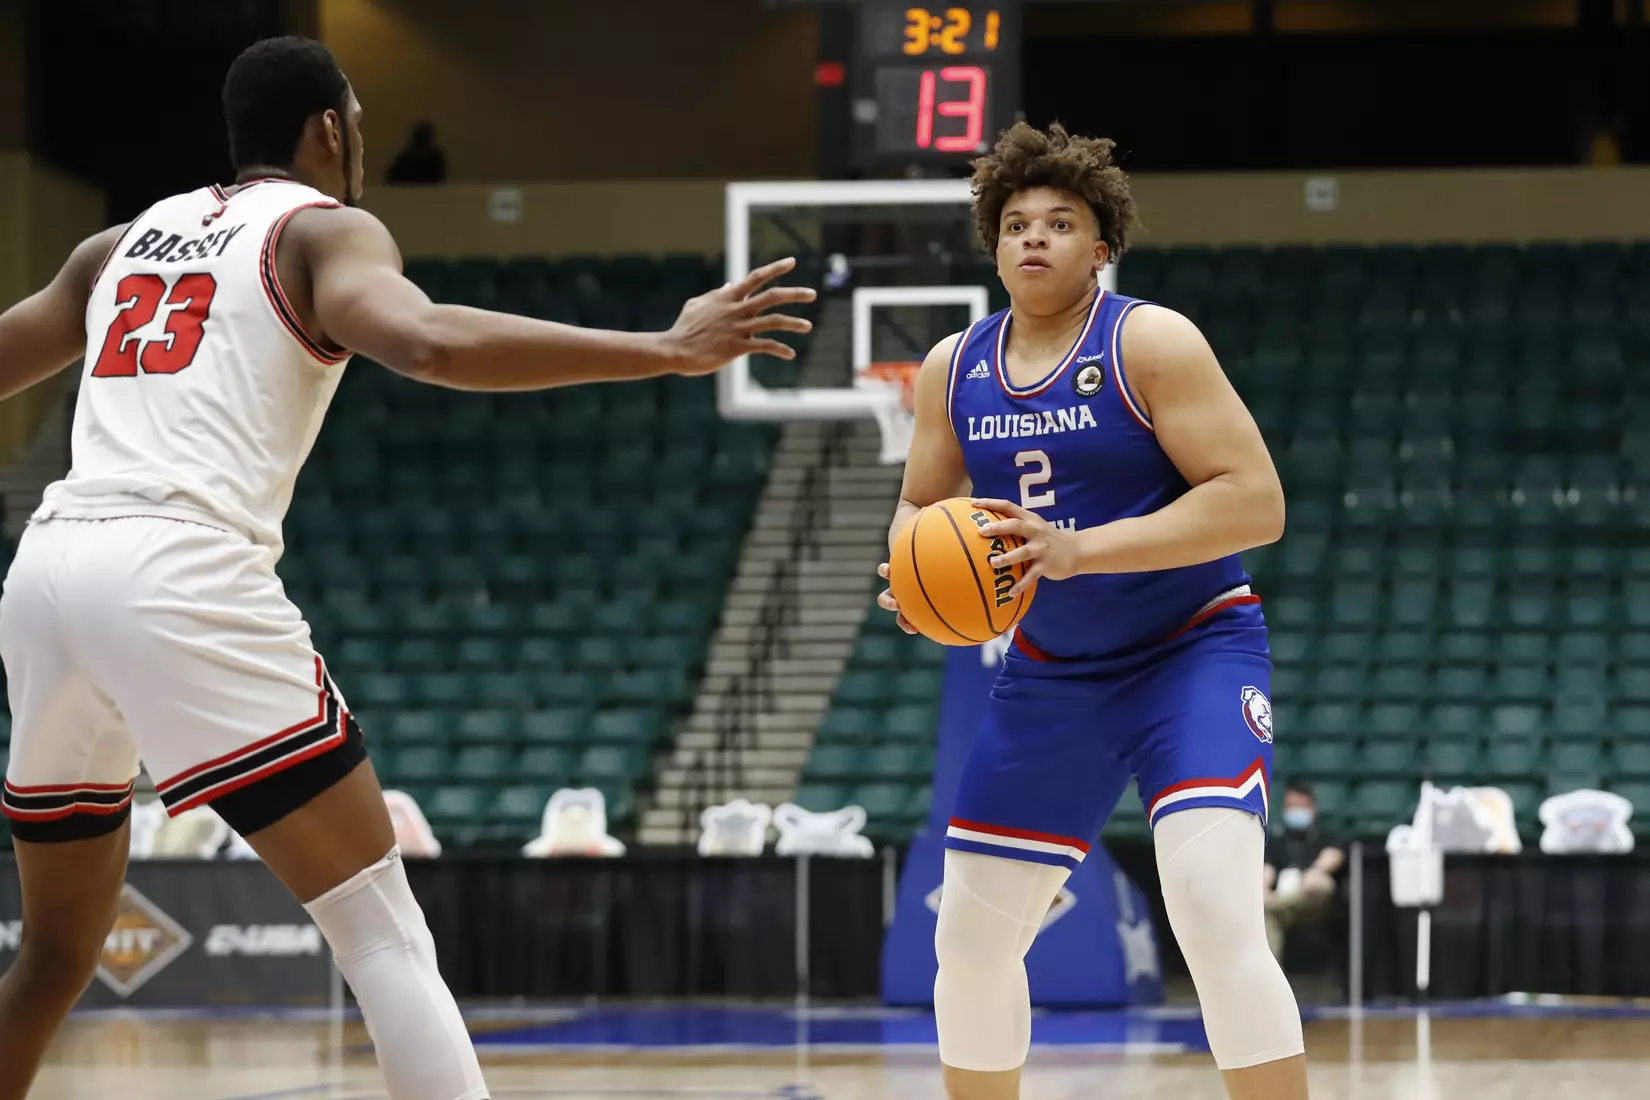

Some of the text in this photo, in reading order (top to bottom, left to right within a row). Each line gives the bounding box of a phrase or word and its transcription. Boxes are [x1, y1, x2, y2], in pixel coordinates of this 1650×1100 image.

[902, 7, 1001, 55] 3:21
[916, 66, 986, 152] 13
[124, 223, 247, 263] BASSEY
[91, 273, 217, 378] 23
[966, 371, 991, 379] adidas
[968, 404, 1098, 441] LOUISIANA
[1014, 450, 1056, 509] 2
